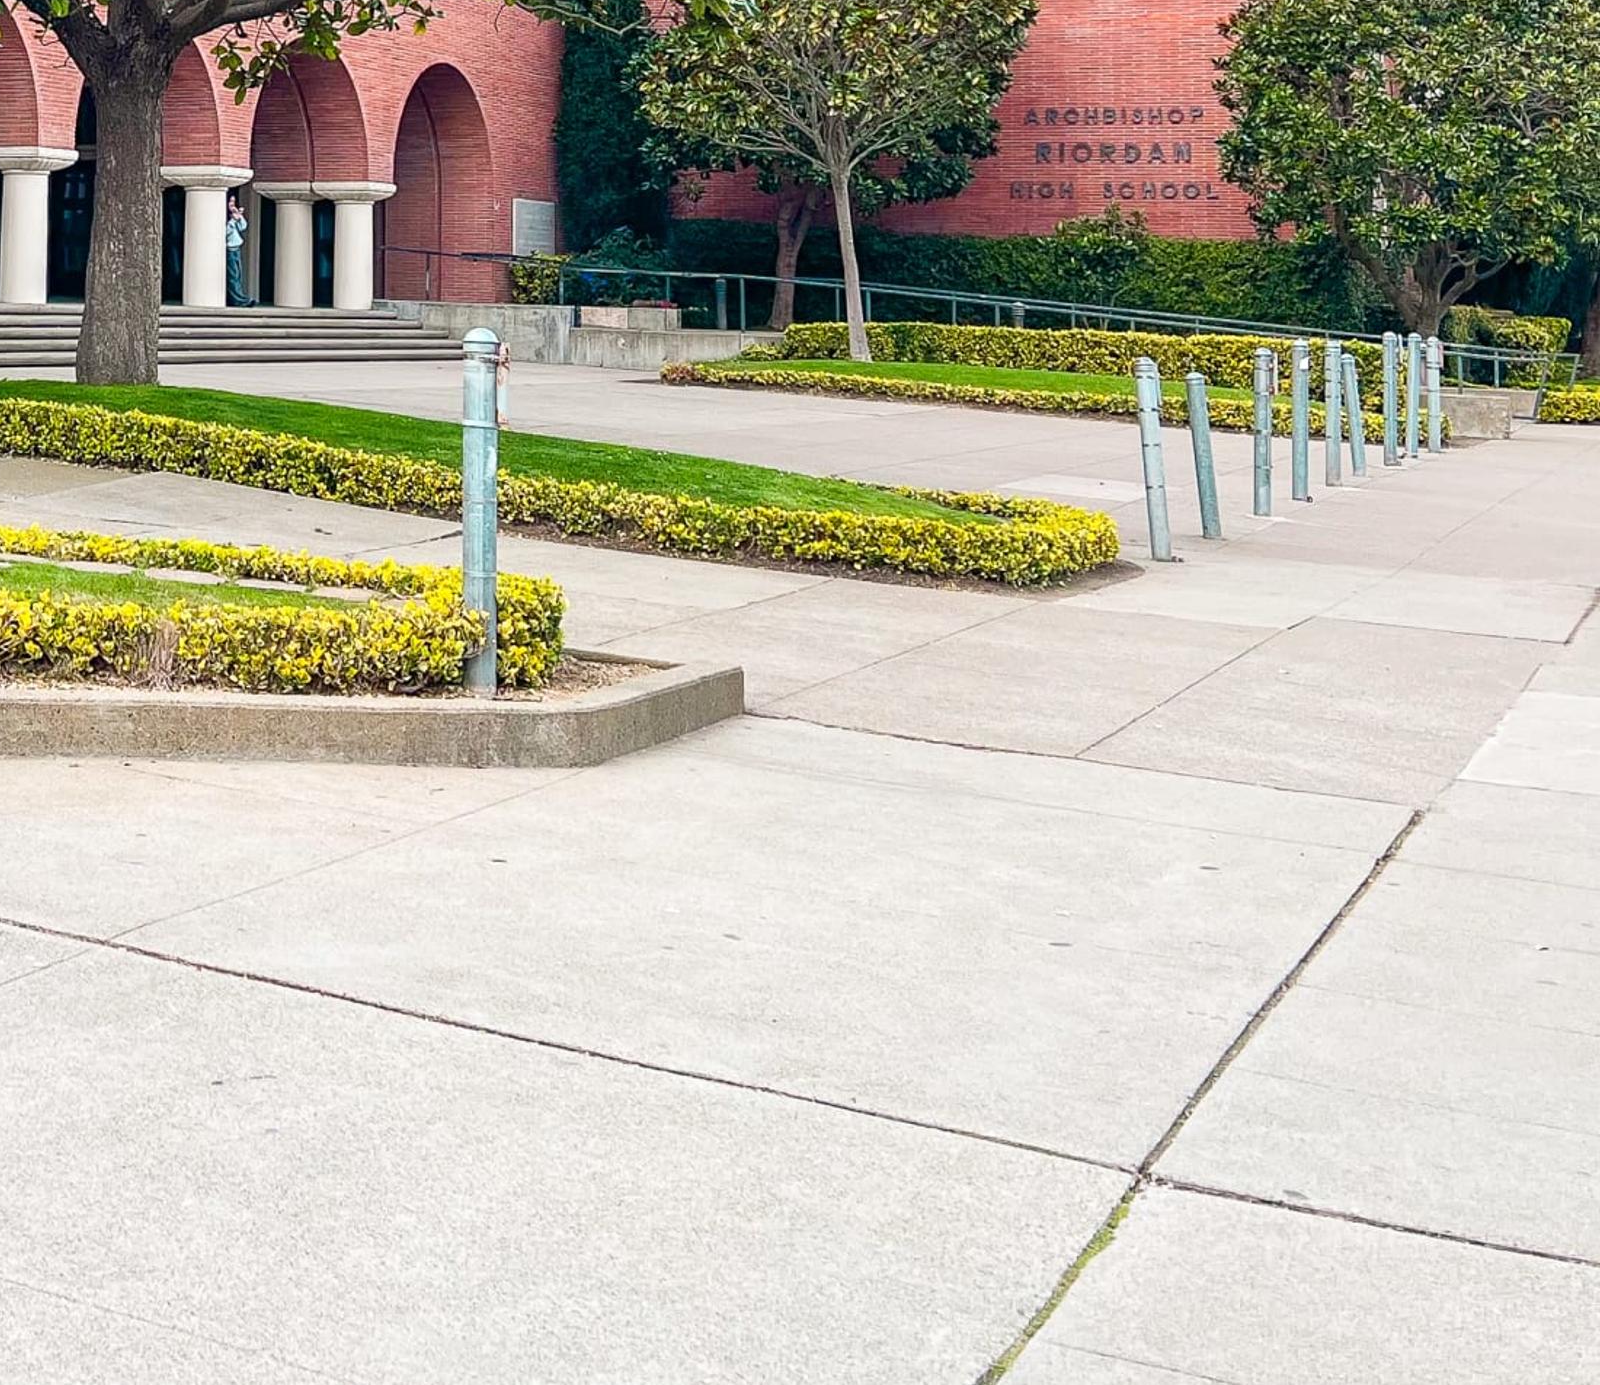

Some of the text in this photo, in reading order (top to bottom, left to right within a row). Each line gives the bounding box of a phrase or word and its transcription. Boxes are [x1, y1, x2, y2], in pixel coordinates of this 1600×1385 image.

[1024, 105, 1204, 125] ARCHBISHOP
[1036, 141, 1192, 163] RIORDAN
[1010, 180, 1219, 200] HIGH SCHOOL
